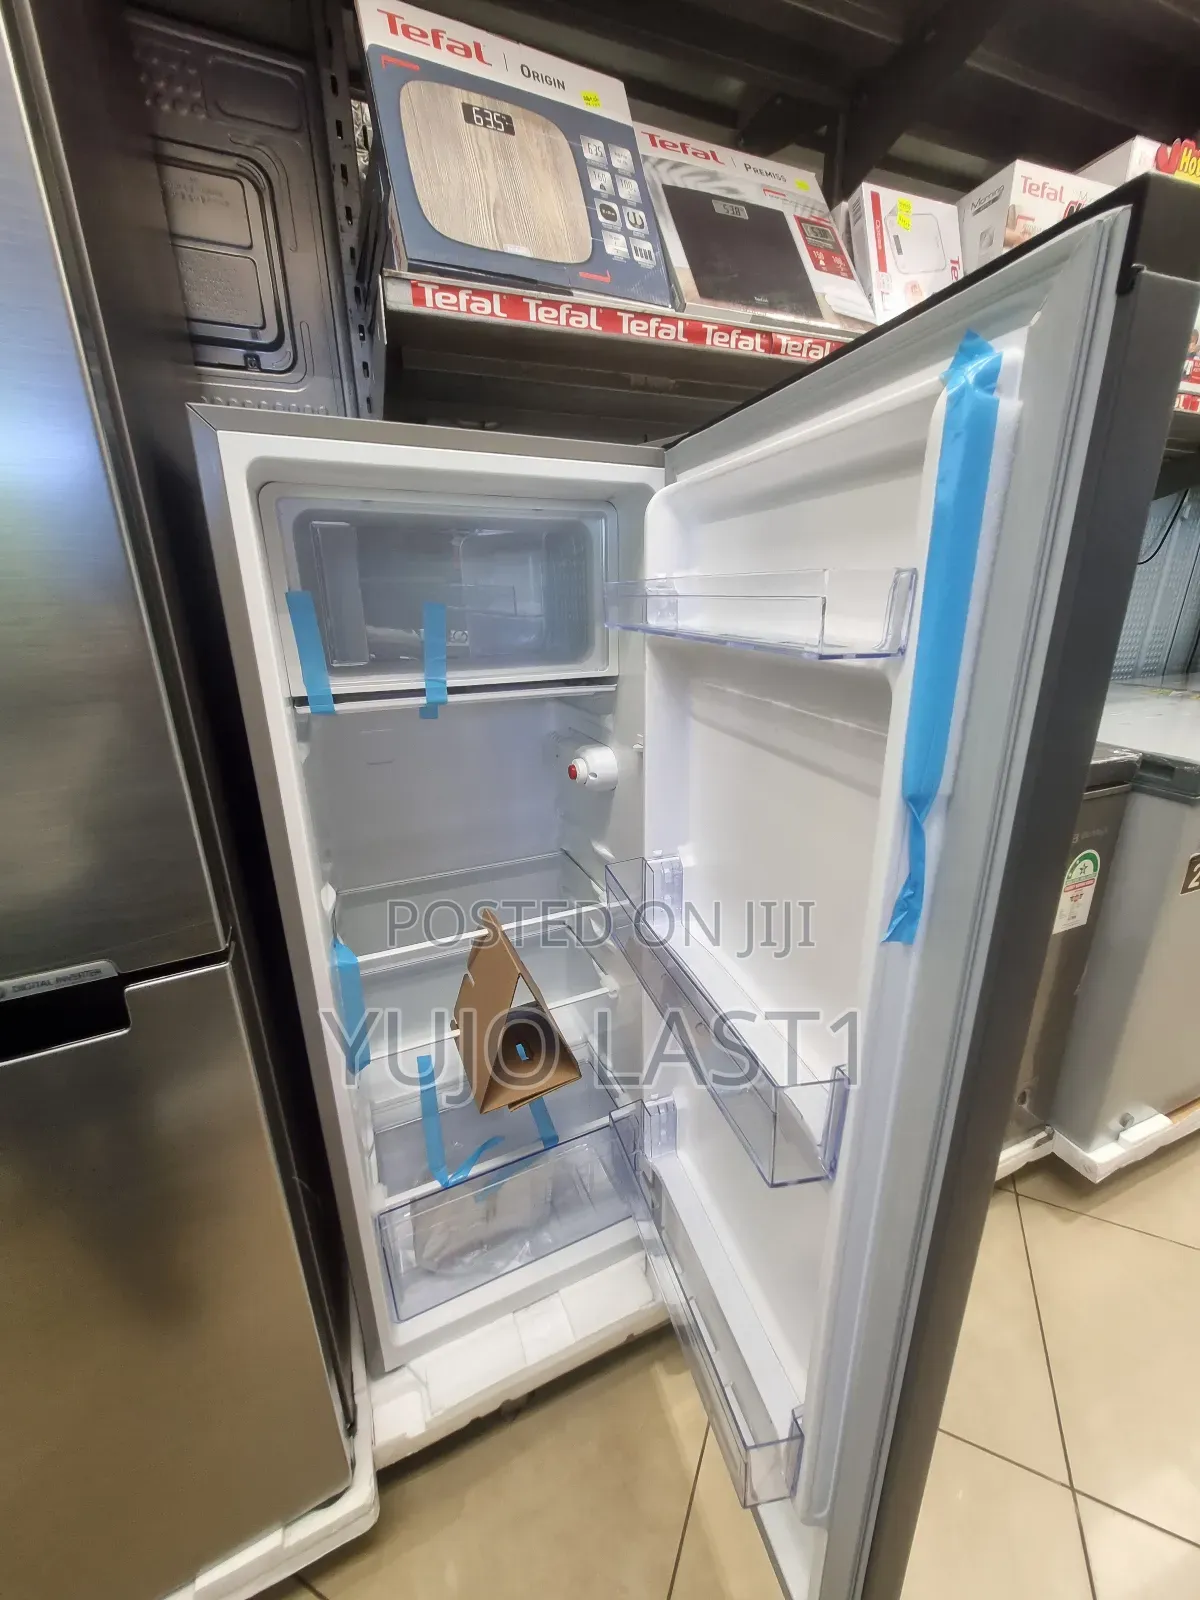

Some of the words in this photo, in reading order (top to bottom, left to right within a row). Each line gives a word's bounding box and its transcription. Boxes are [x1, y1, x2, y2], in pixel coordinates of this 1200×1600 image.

[376, 8, 493, 67] Tefal
[520, 63, 566, 91] ORIGIN
[641, 131, 726, 165] Tefal
[1021, 175, 1065, 204] Tefal
[417, 283, 508, 319] Tefal
[522, 298, 604, 332] Tefal
[616, 311, 690, 343] Tefal
[702, 324, 767, 353] Tefal
[775, 334, 834, 360] Tefal
[12, 979, 53, 993] DIGITAL
